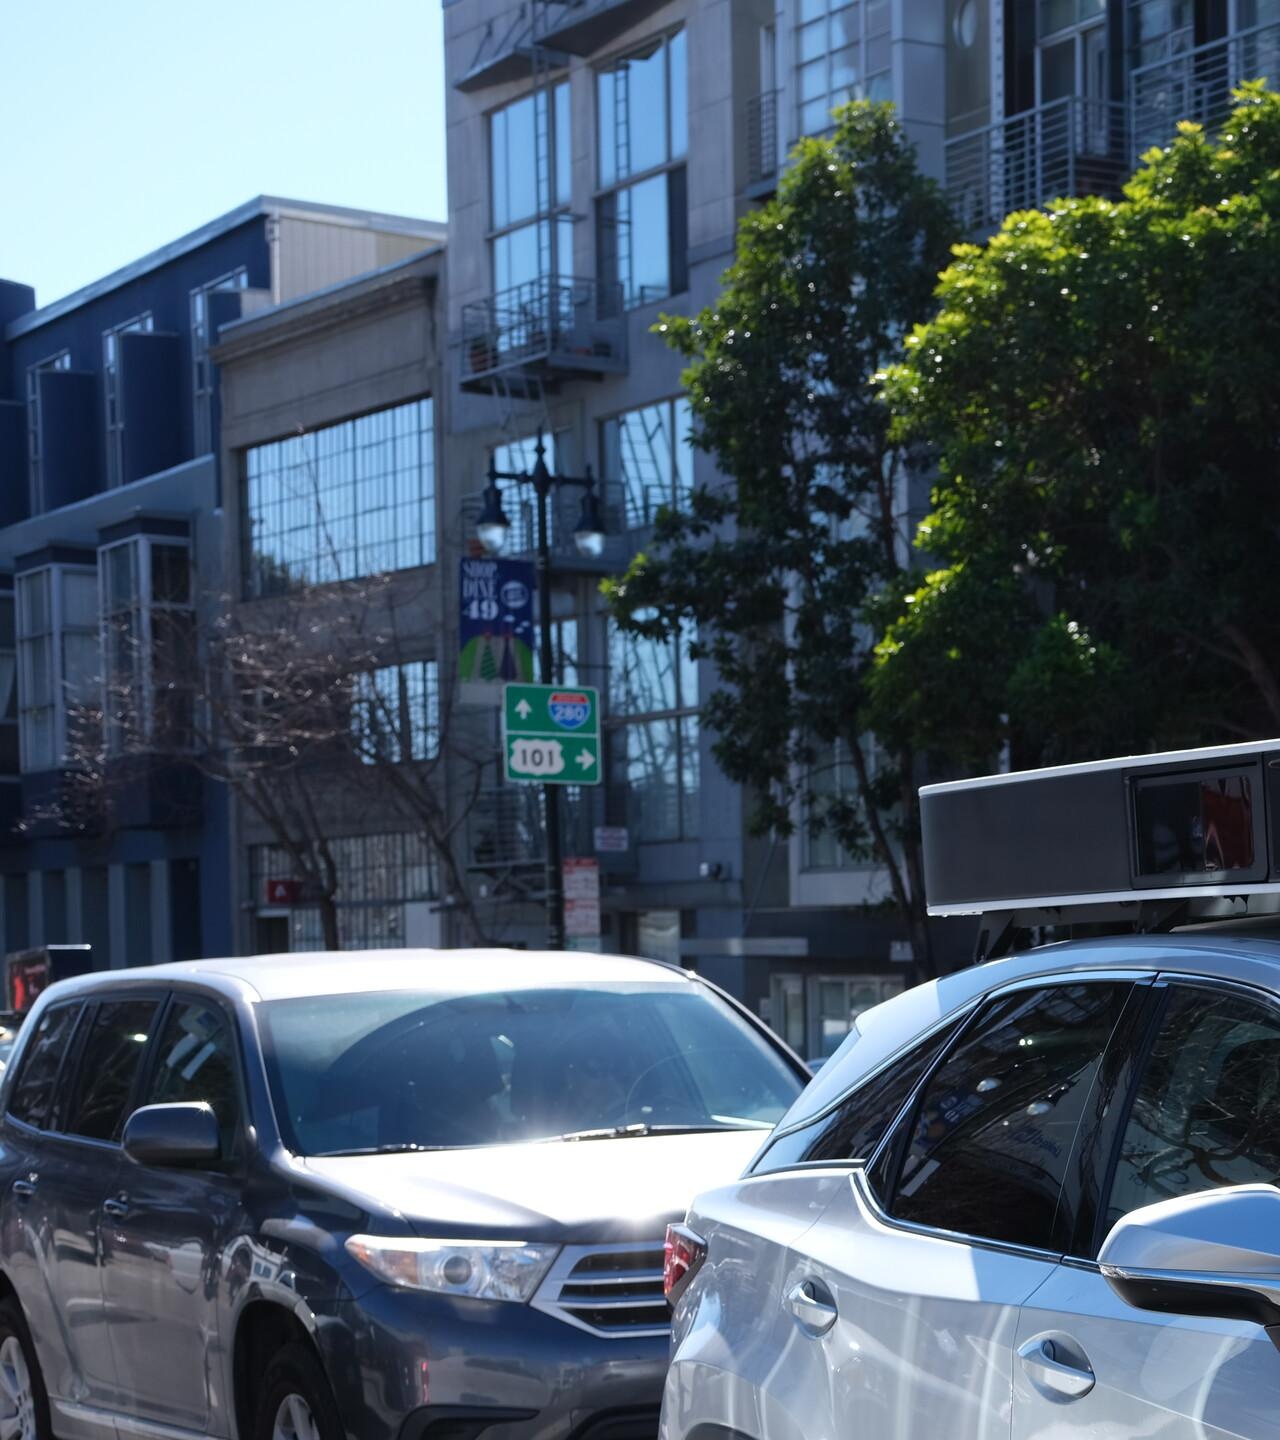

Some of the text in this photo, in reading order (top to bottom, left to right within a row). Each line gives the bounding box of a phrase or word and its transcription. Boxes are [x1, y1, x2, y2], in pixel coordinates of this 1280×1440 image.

[463, 577, 498, 599] DINE
[462, 599, 499, 620] 49
[553, 704, 585, 721] 280
[520, 748, 556, 767] 101
